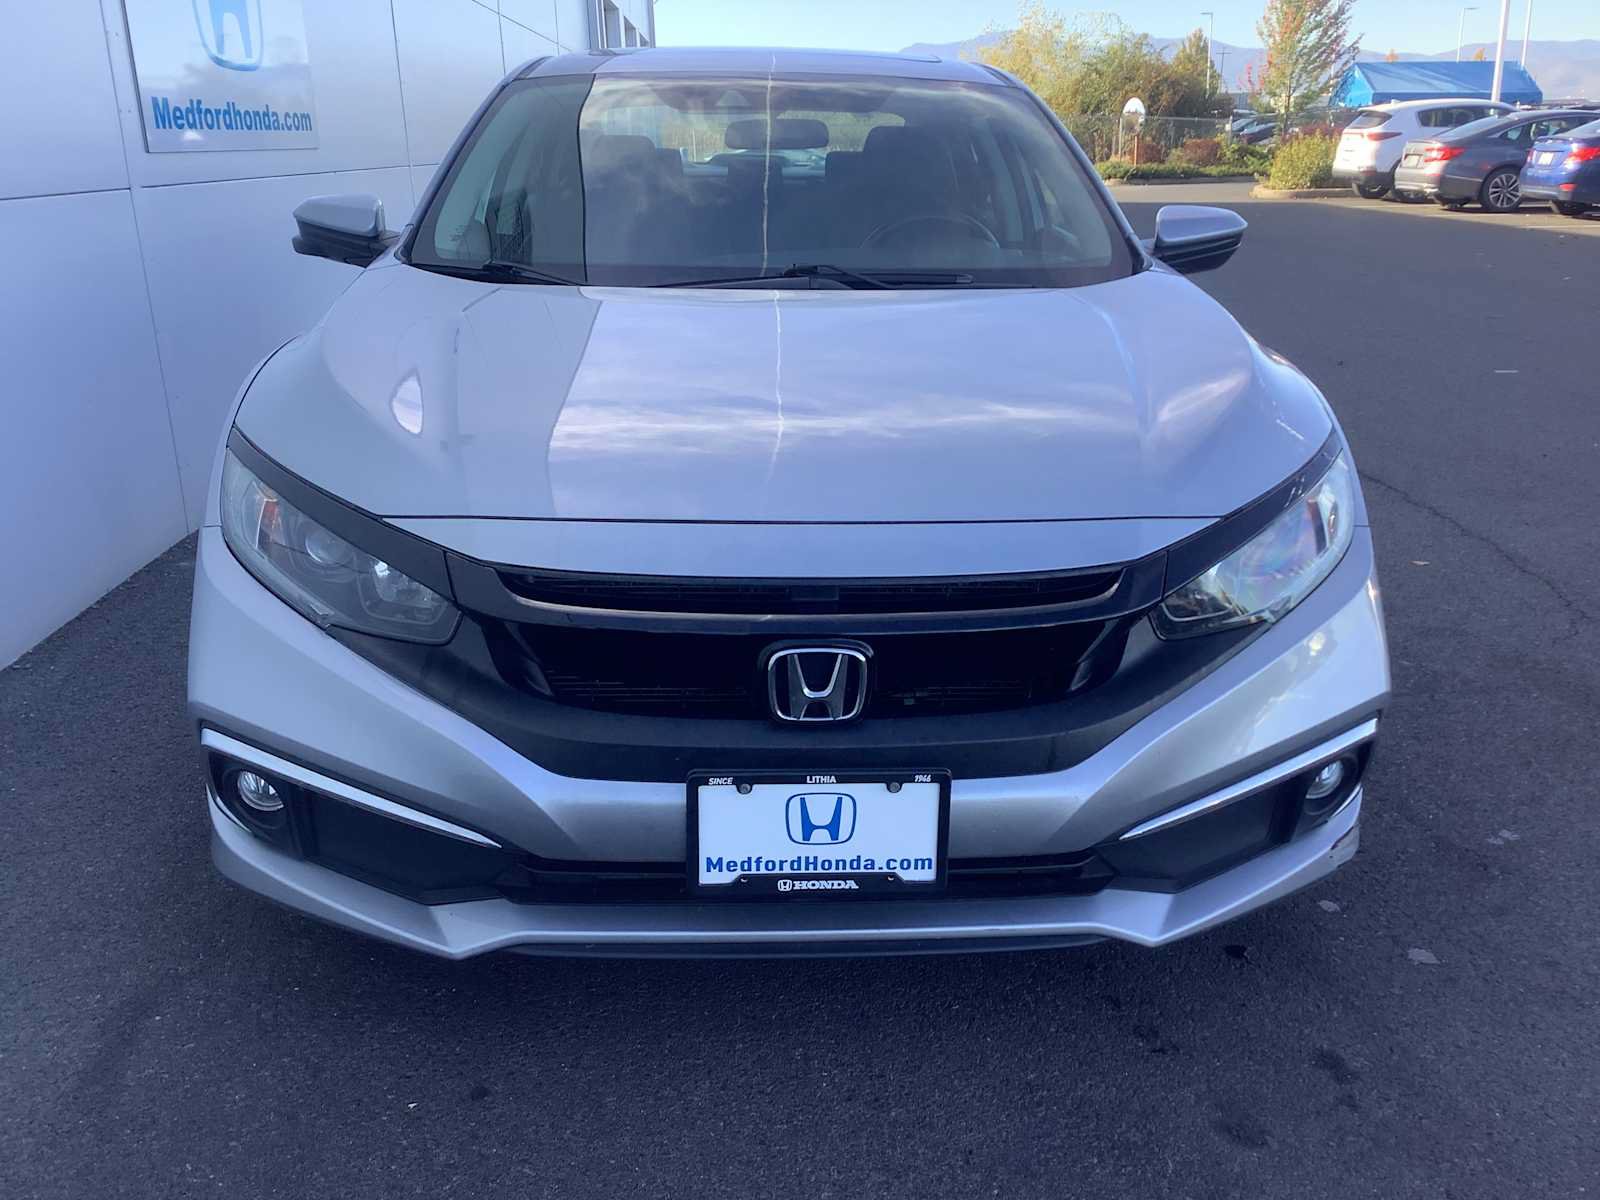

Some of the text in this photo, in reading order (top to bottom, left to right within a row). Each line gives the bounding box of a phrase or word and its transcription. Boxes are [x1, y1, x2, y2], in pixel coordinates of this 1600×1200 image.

[151, 96, 313, 132] Medfordhonda.com
[708, 777, 734, 786] SINCE
[806, 775, 837, 784] LITHIA
[706, 855, 933, 873] MedfordHonda.com
[793, 879, 859, 890] HONDA
